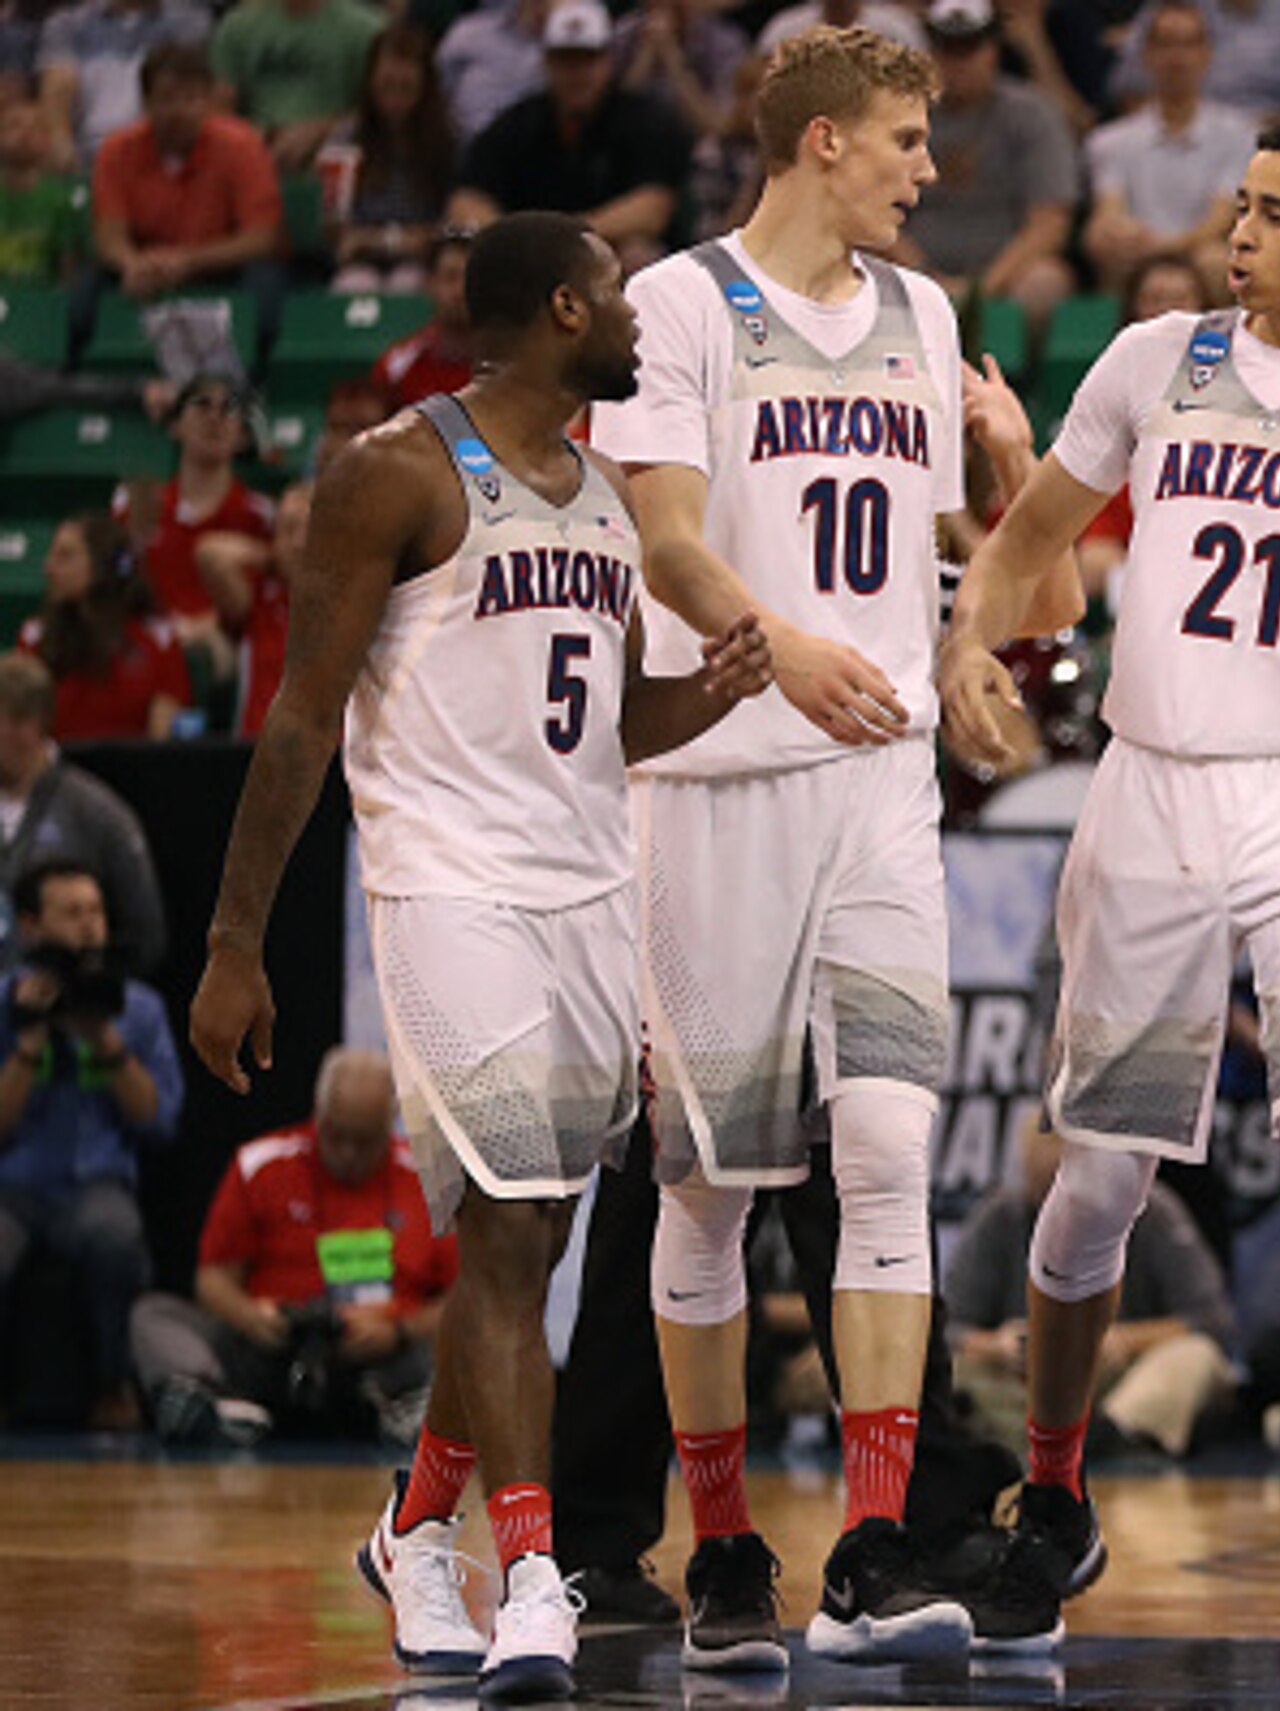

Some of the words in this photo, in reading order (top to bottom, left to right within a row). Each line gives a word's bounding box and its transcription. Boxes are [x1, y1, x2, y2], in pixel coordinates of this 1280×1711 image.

[750, 396, 931, 469] ARIZONA
[801, 477, 889, 596] 10
[546, 633, 591, 755] 5
